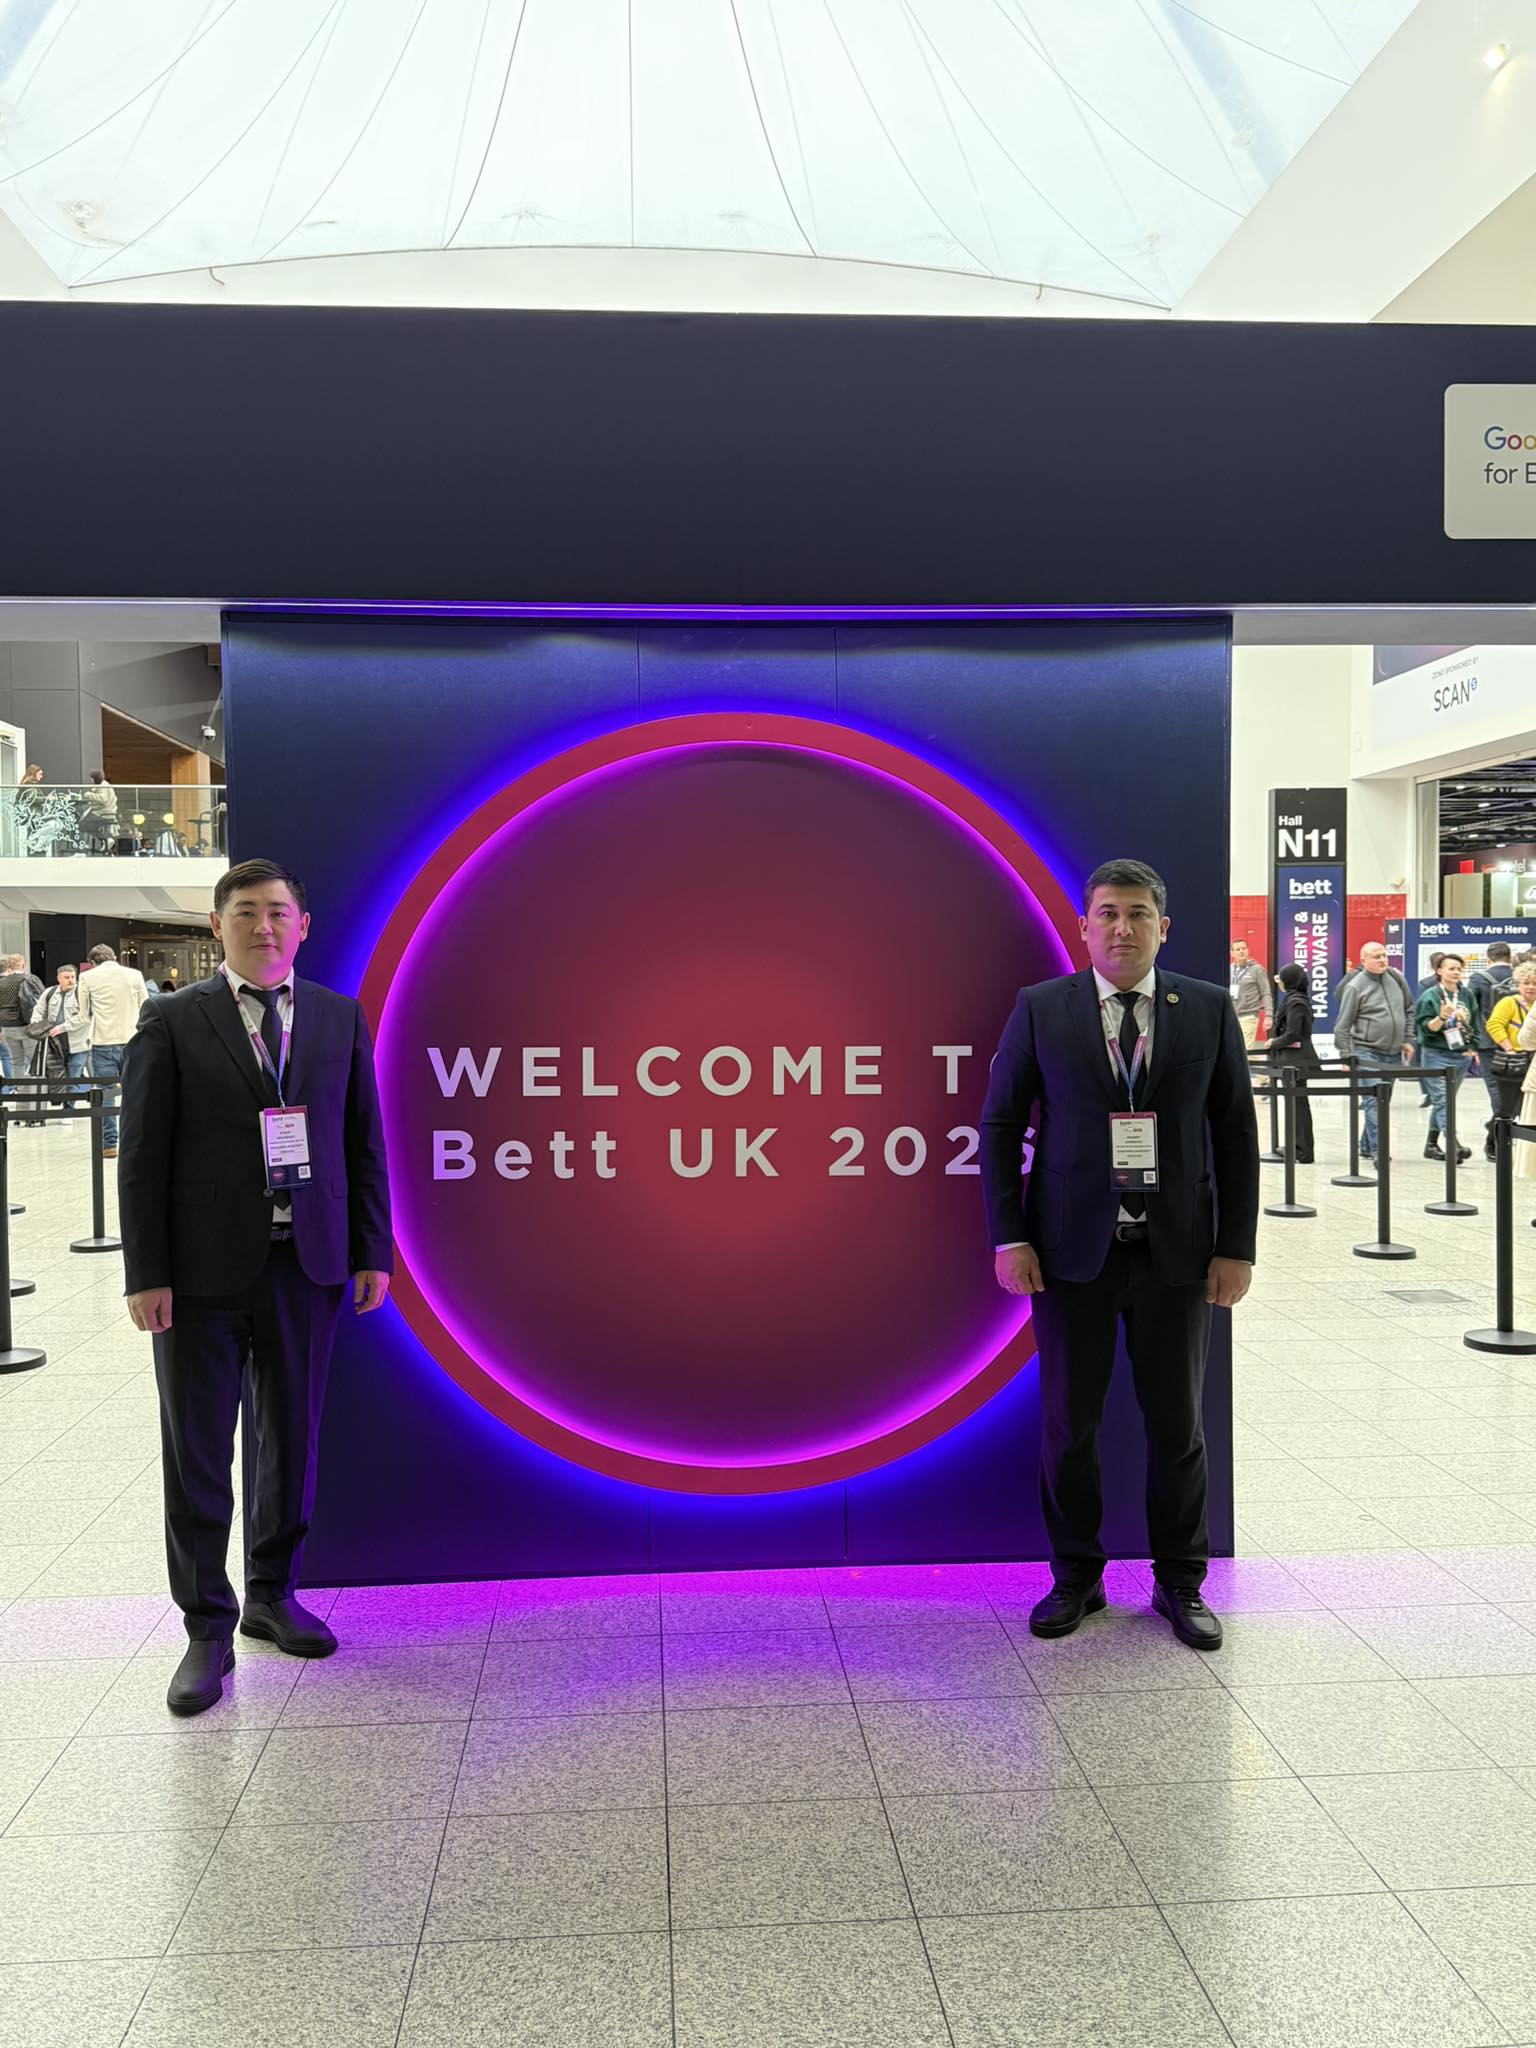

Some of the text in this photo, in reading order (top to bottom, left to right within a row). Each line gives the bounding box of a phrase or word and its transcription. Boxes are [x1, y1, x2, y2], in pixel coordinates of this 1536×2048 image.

[1484, 426, 1536, 450] Goo
[1484, 462, 1518, 484] for
[1278, 815, 1303, 826] Hall
[1278, 828, 1337, 858] N11
[1289, 878, 1333, 895] bett
[1294, 911, 1308, 923] &
[1419, 922, 1529, 935] bett You Are Here
[1312, 912, 1328, 1018] HARDWARE
[427, 1045, 999, 1097] WELCOME T
[433, 1128, 617, 1180] Bett
[669, 1127, 780, 1178] UK
